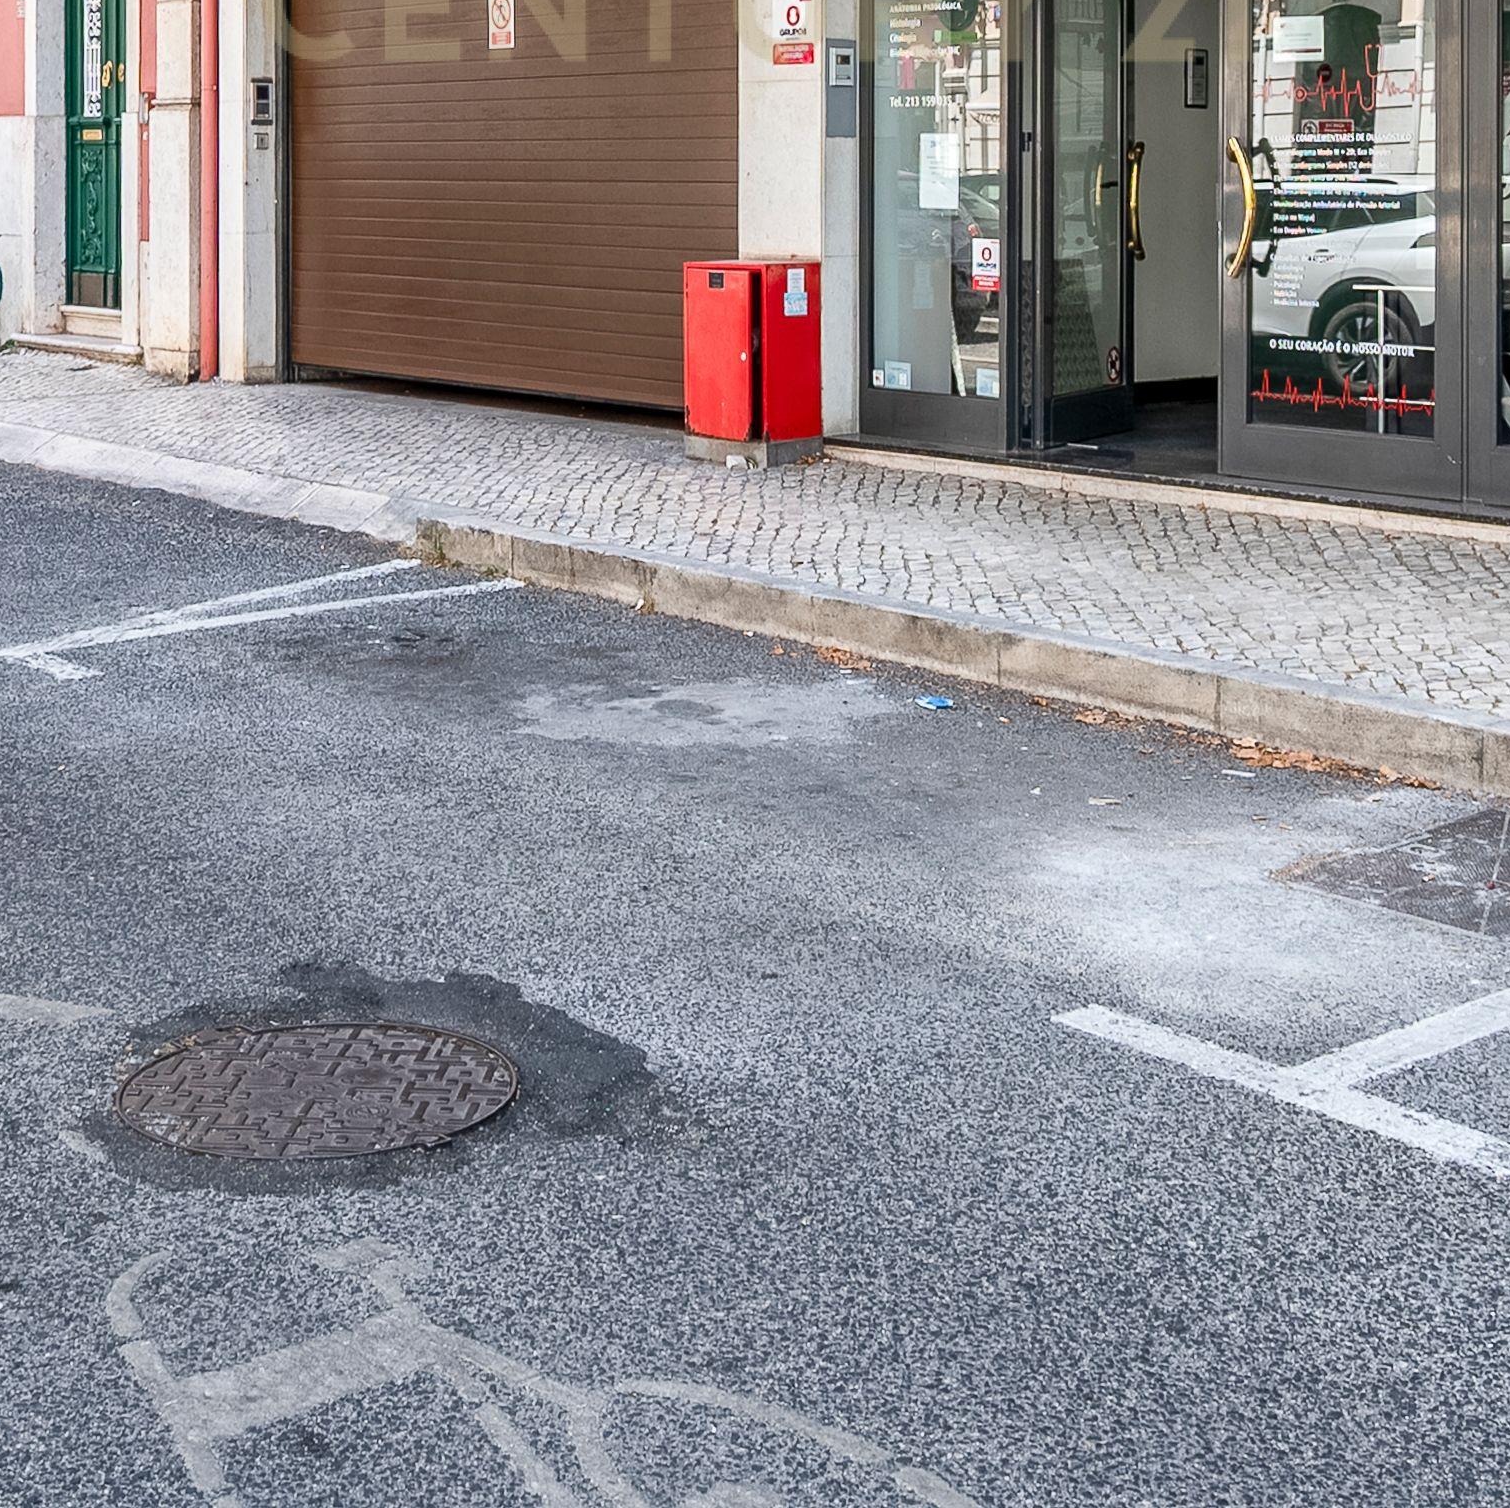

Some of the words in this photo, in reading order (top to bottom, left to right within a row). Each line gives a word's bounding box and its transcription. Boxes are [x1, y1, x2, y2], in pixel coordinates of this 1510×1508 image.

[889, 95, 904, 108] Tel.
[905, 95, 920, 108] 213
[1269, 339, 1277, 350] O
[1278, 339, 1294, 350] SEU
[1295, 338, 1335, 355] CORAÇÃO
